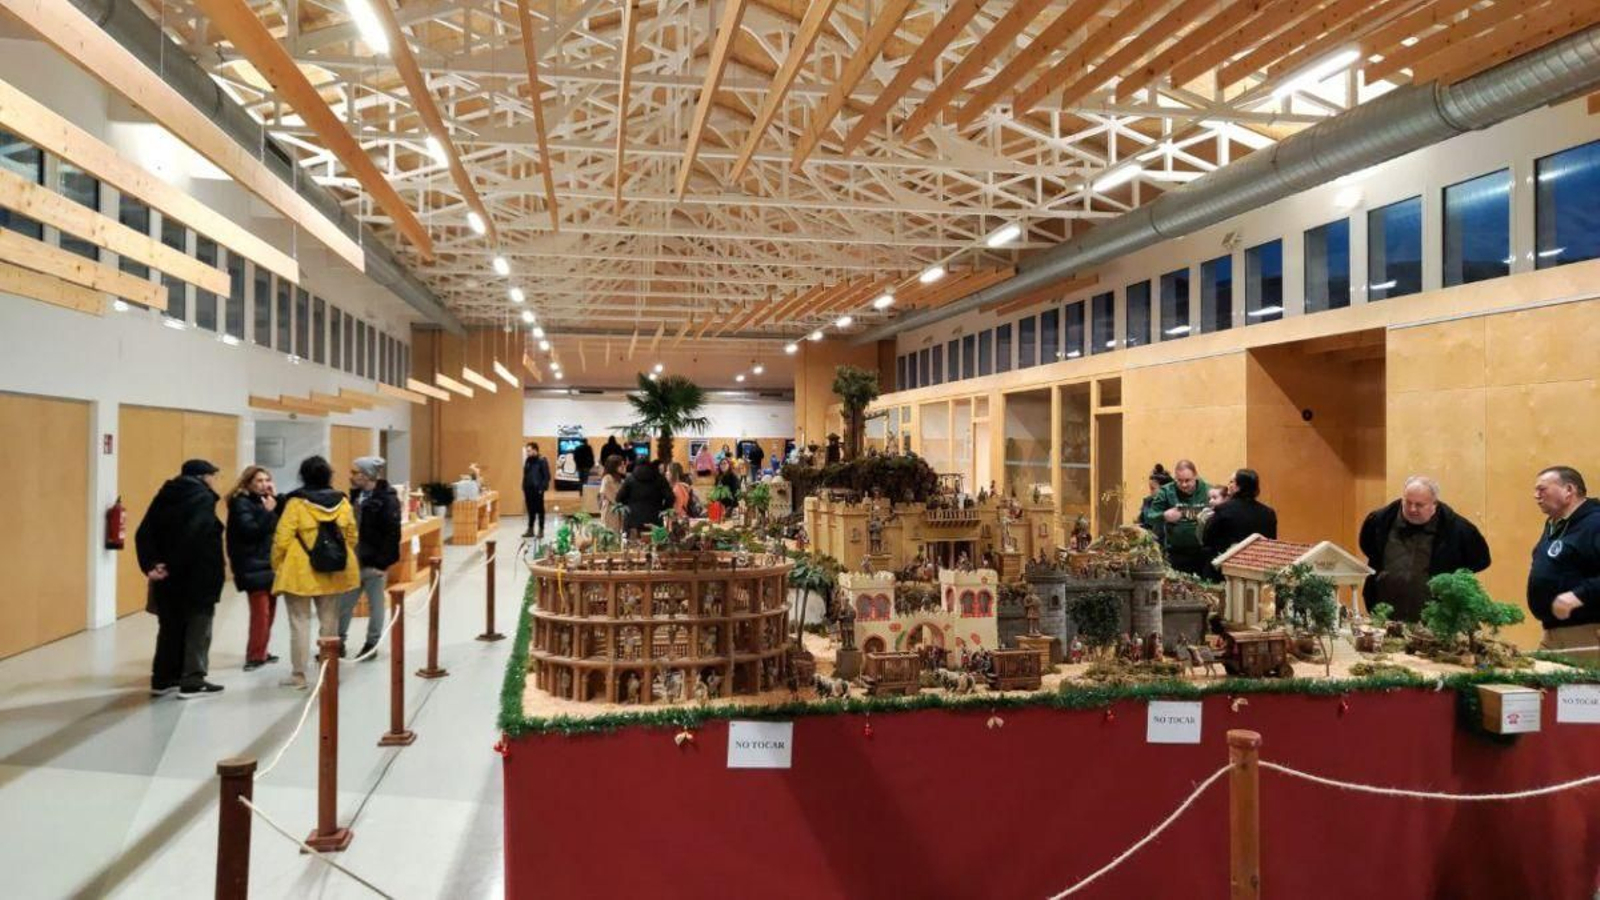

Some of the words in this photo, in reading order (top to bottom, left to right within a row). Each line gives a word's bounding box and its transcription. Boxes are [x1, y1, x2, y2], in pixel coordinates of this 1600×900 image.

[1153, 715, 1167, 724] NO
[1168, 715, 1196, 725] TOCAR
[735, 740, 750, 749] NO
[752, 740, 785, 749] TOCAR
